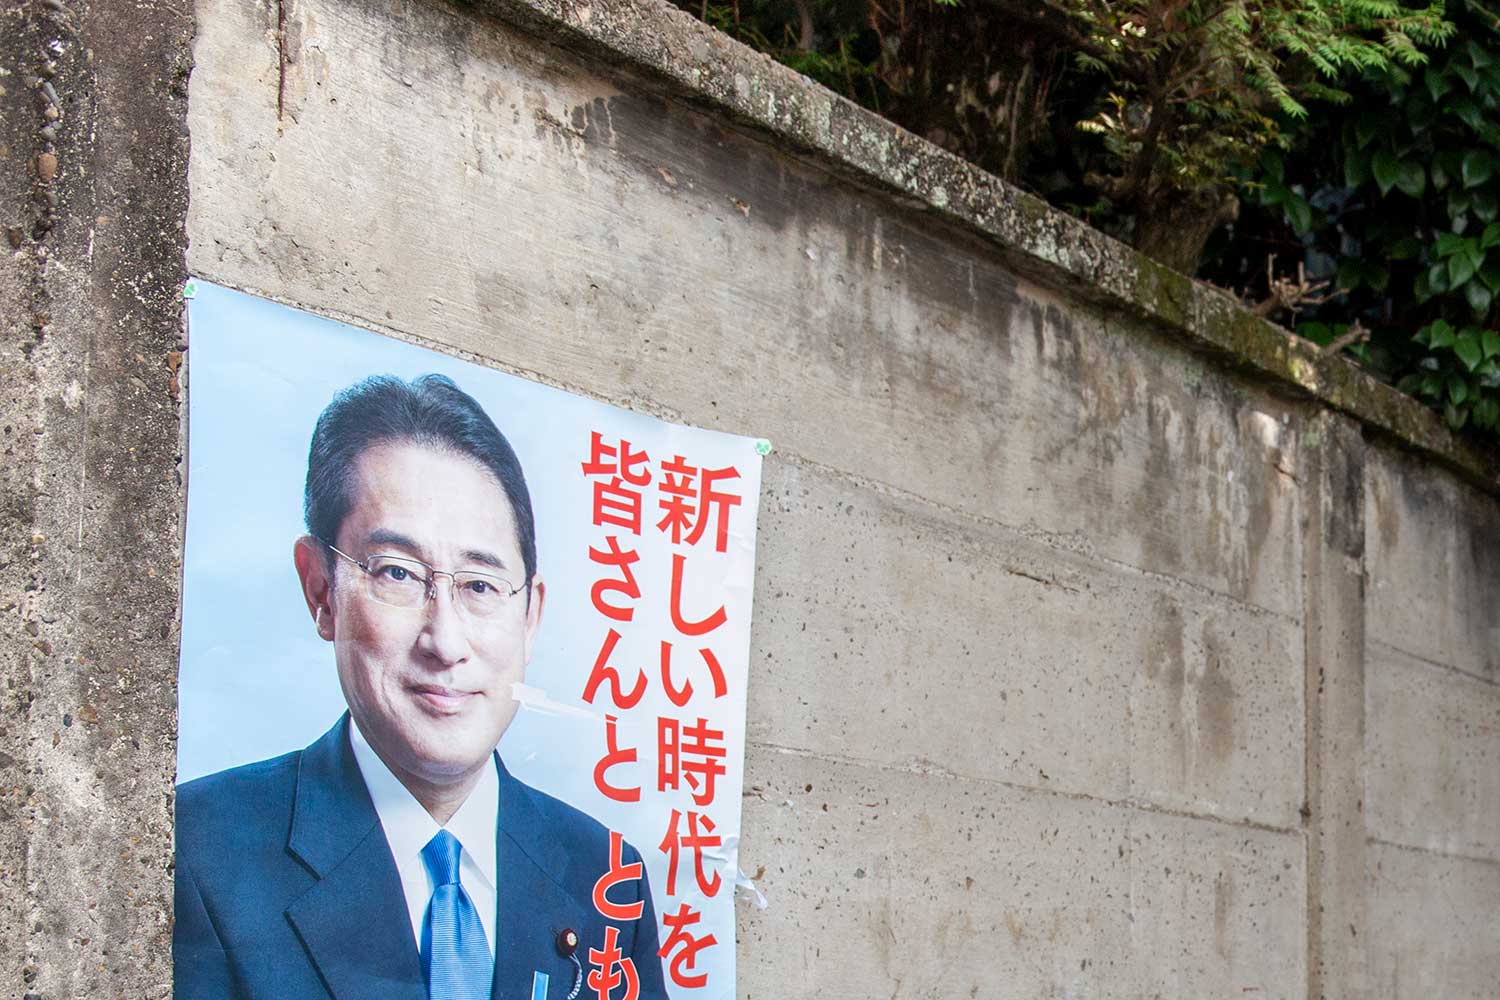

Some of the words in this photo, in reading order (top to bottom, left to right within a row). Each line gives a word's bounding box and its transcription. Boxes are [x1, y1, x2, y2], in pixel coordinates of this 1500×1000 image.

[656, 454, 742, 989] 新しい時代を
